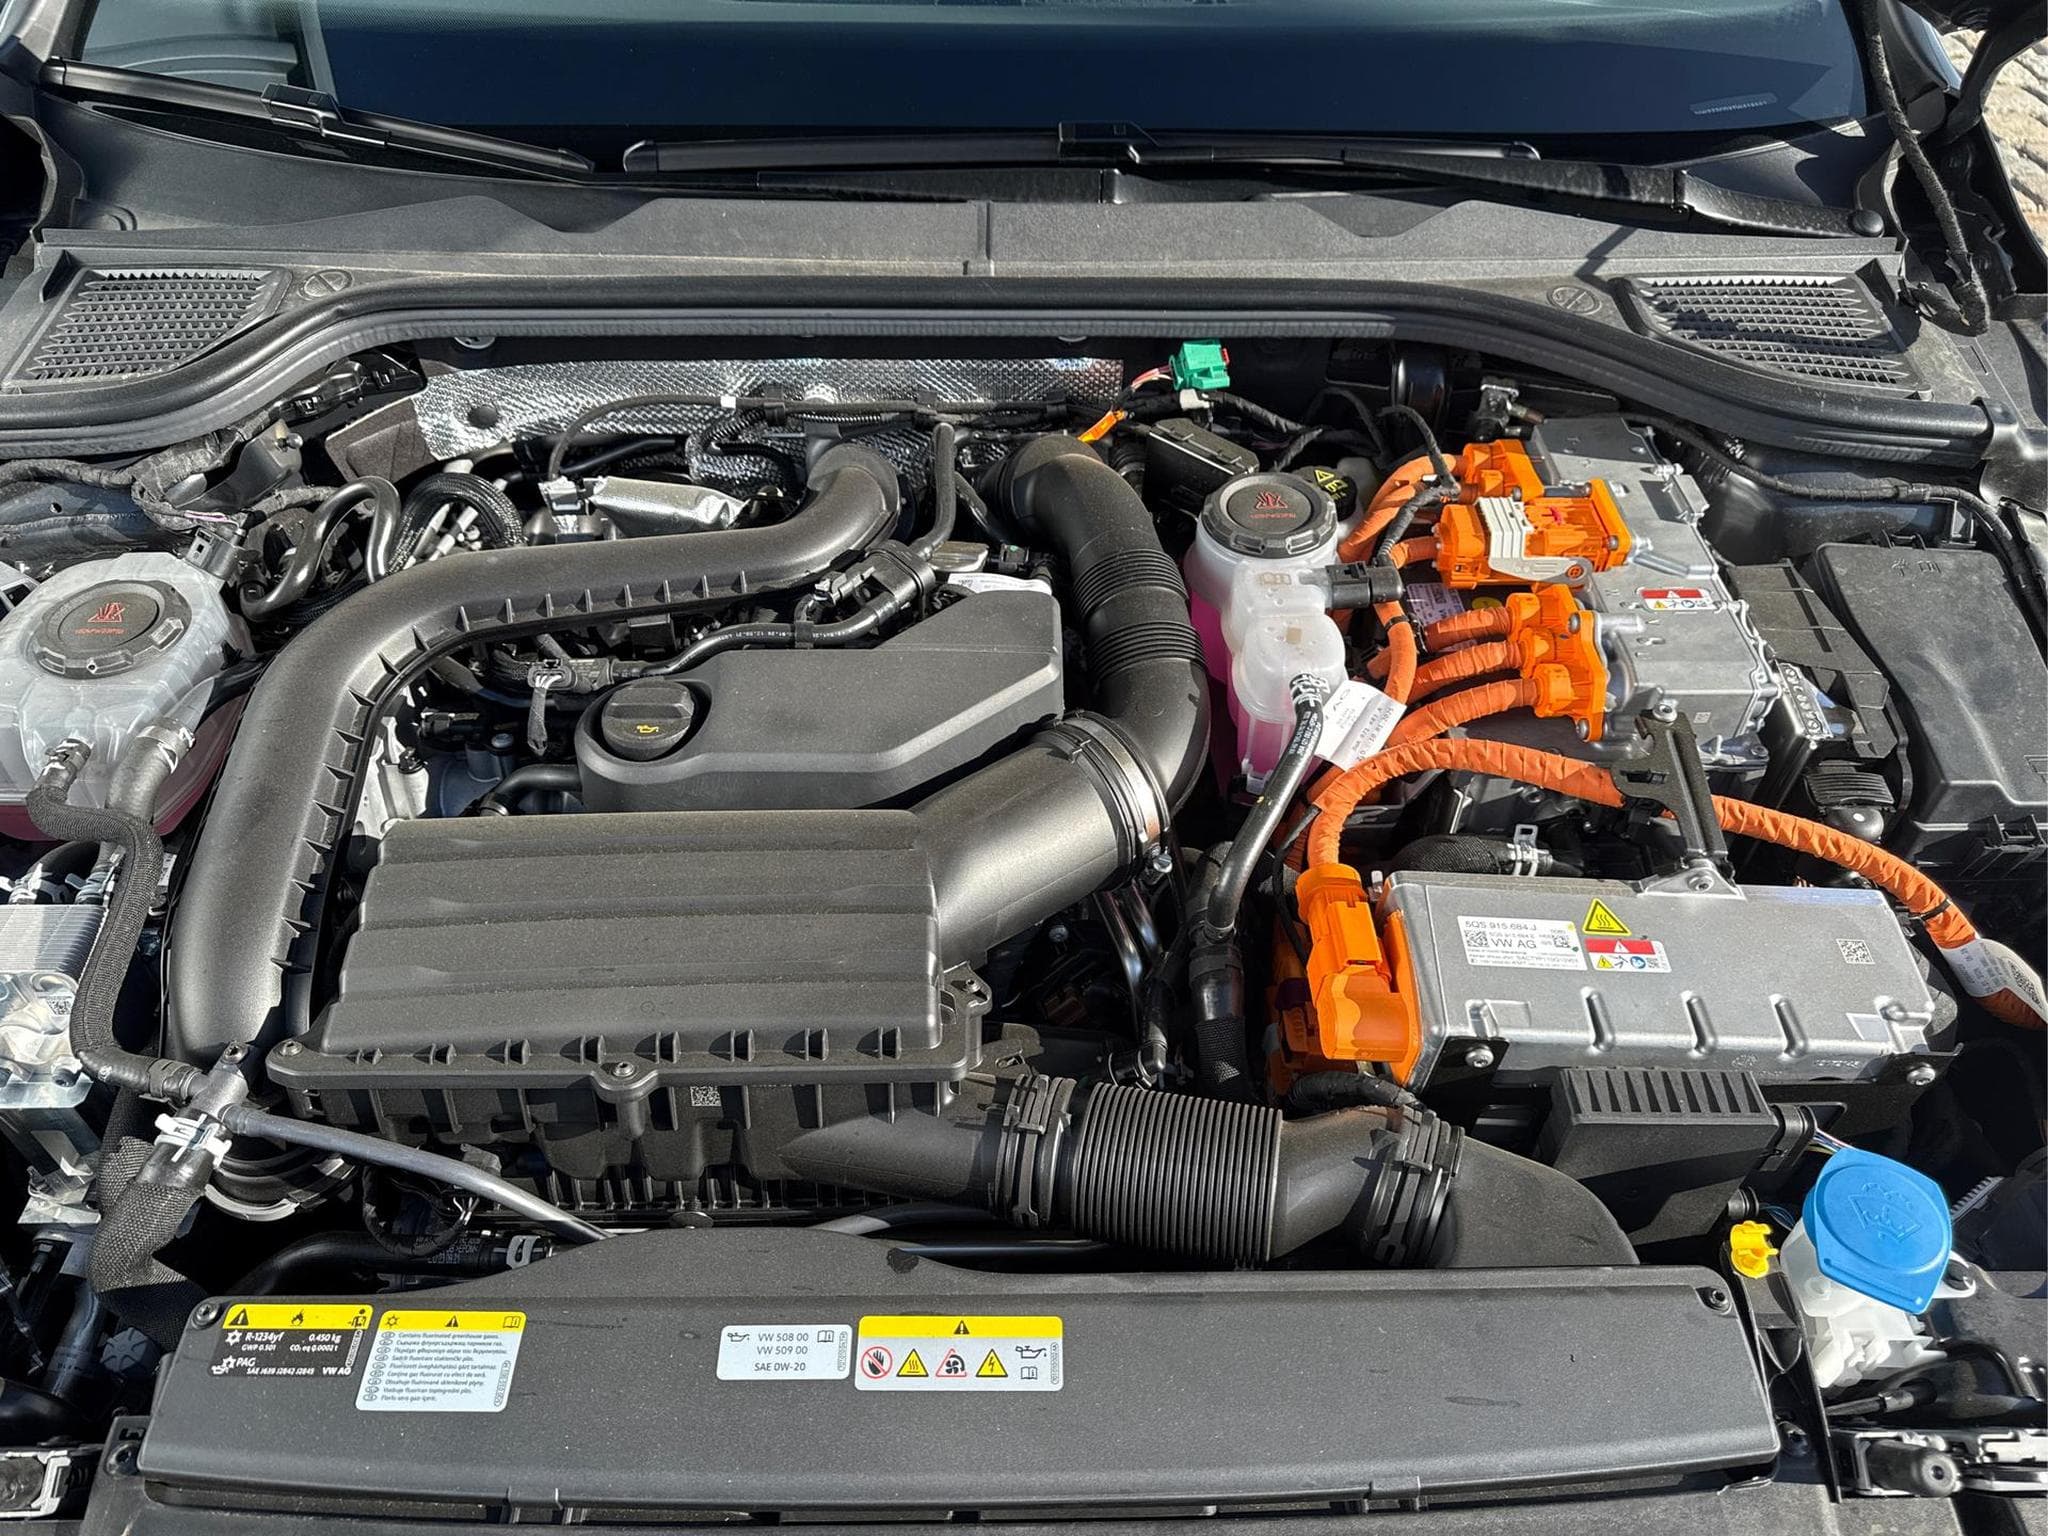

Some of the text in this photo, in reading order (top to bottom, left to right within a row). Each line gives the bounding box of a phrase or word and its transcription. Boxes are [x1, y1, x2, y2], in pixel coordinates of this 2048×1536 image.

[1490, 938, 1537, 949] VW AG
[245, 1331, 342, 1344] R-1234yf 0.450 kg
[758, 1333, 809, 1341] VW 508 00
[757, 1346, 808, 1354] VW 509 00
[236, 1357, 256, 1367] PAG
[754, 1362, 806, 1371] SAE 0W-20
[322, 1367, 338, 1375] VW
[338, 1367, 352, 1375] AG
